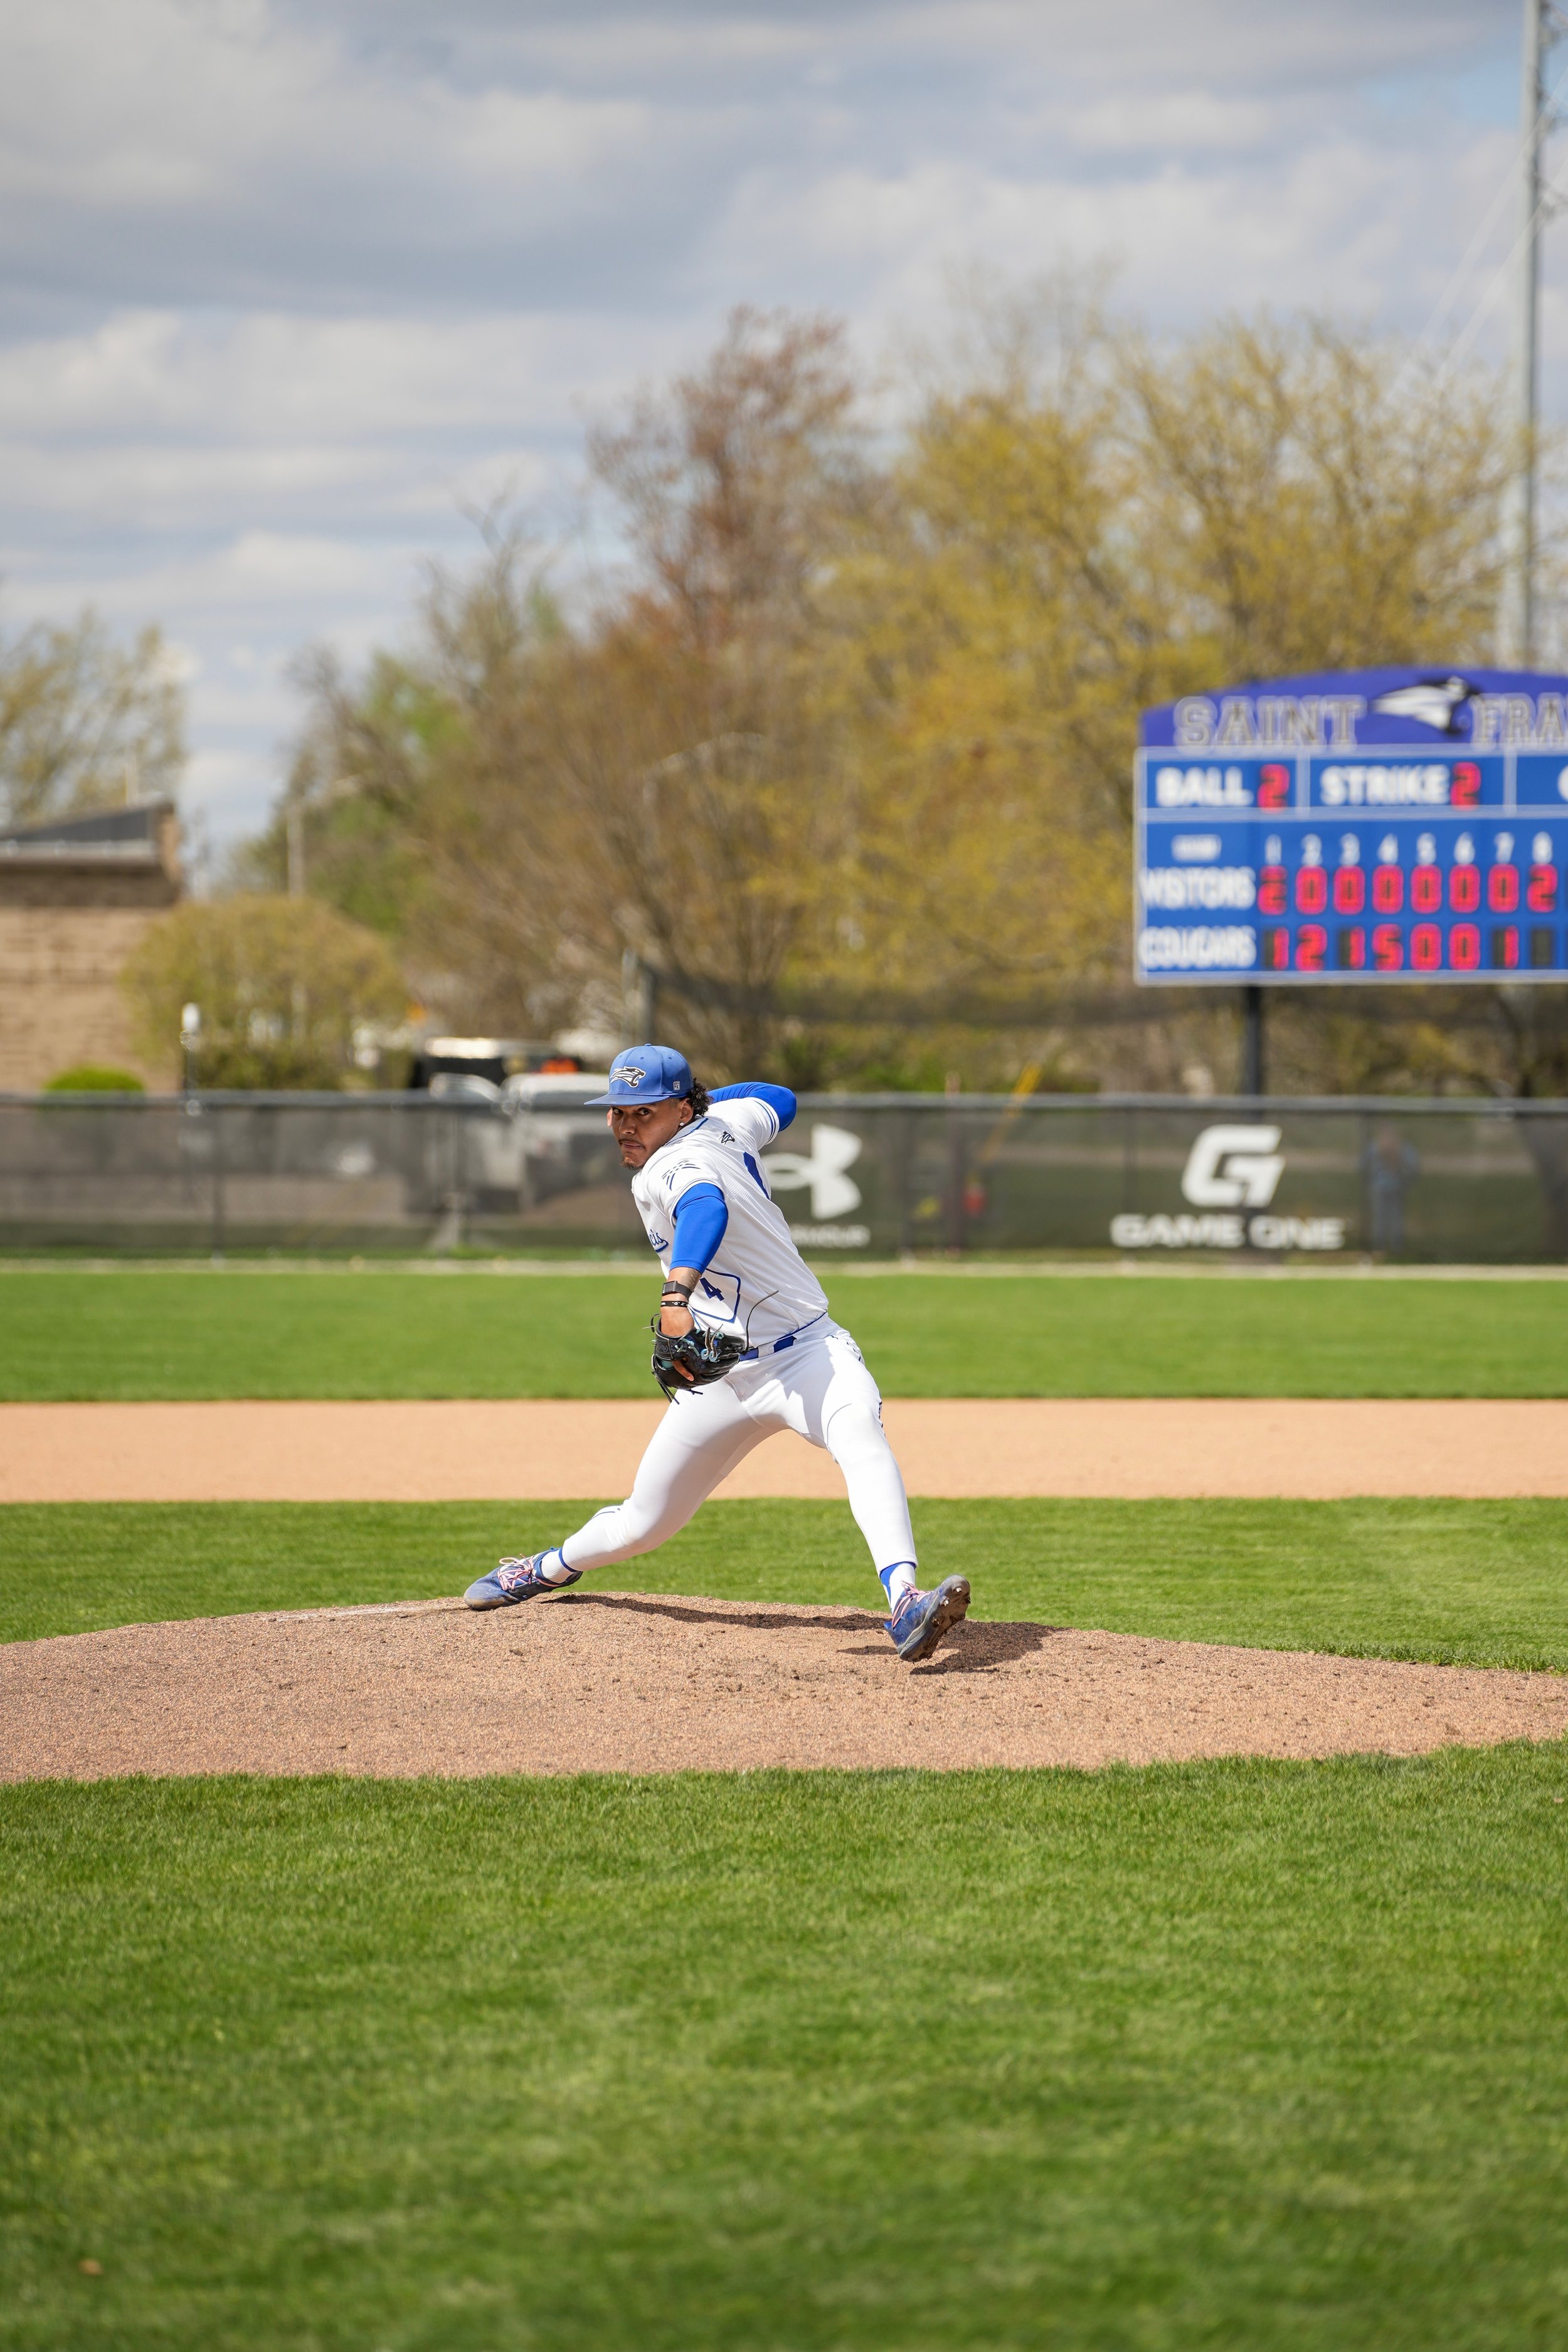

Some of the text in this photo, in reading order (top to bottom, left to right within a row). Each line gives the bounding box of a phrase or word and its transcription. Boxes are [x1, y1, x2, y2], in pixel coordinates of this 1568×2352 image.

[1174, 693, 1568, 750] SAINT FRA
[1157, 765, 1289, 811] BALL 2
[1321, 762, 1481, 809] STRIKE 2
[1266, 836, 1281, 865] 1
[1296, 866, 1327, 914] 0
[1334, 866, 1365, 914] 0
[1372, 866, 1404, 913] 0
[1411, 866, 1441, 913] 0
[1449, 865, 1480, 913] 0
[1488, 864, 1518, 912] 0
[1527, 864, 1557, 912] 2
[1139, 923, 1518, 972] COUGARS 1 2 1 5 0 0 1
[1111, 1214, 1344, 1249] GAME ONE
